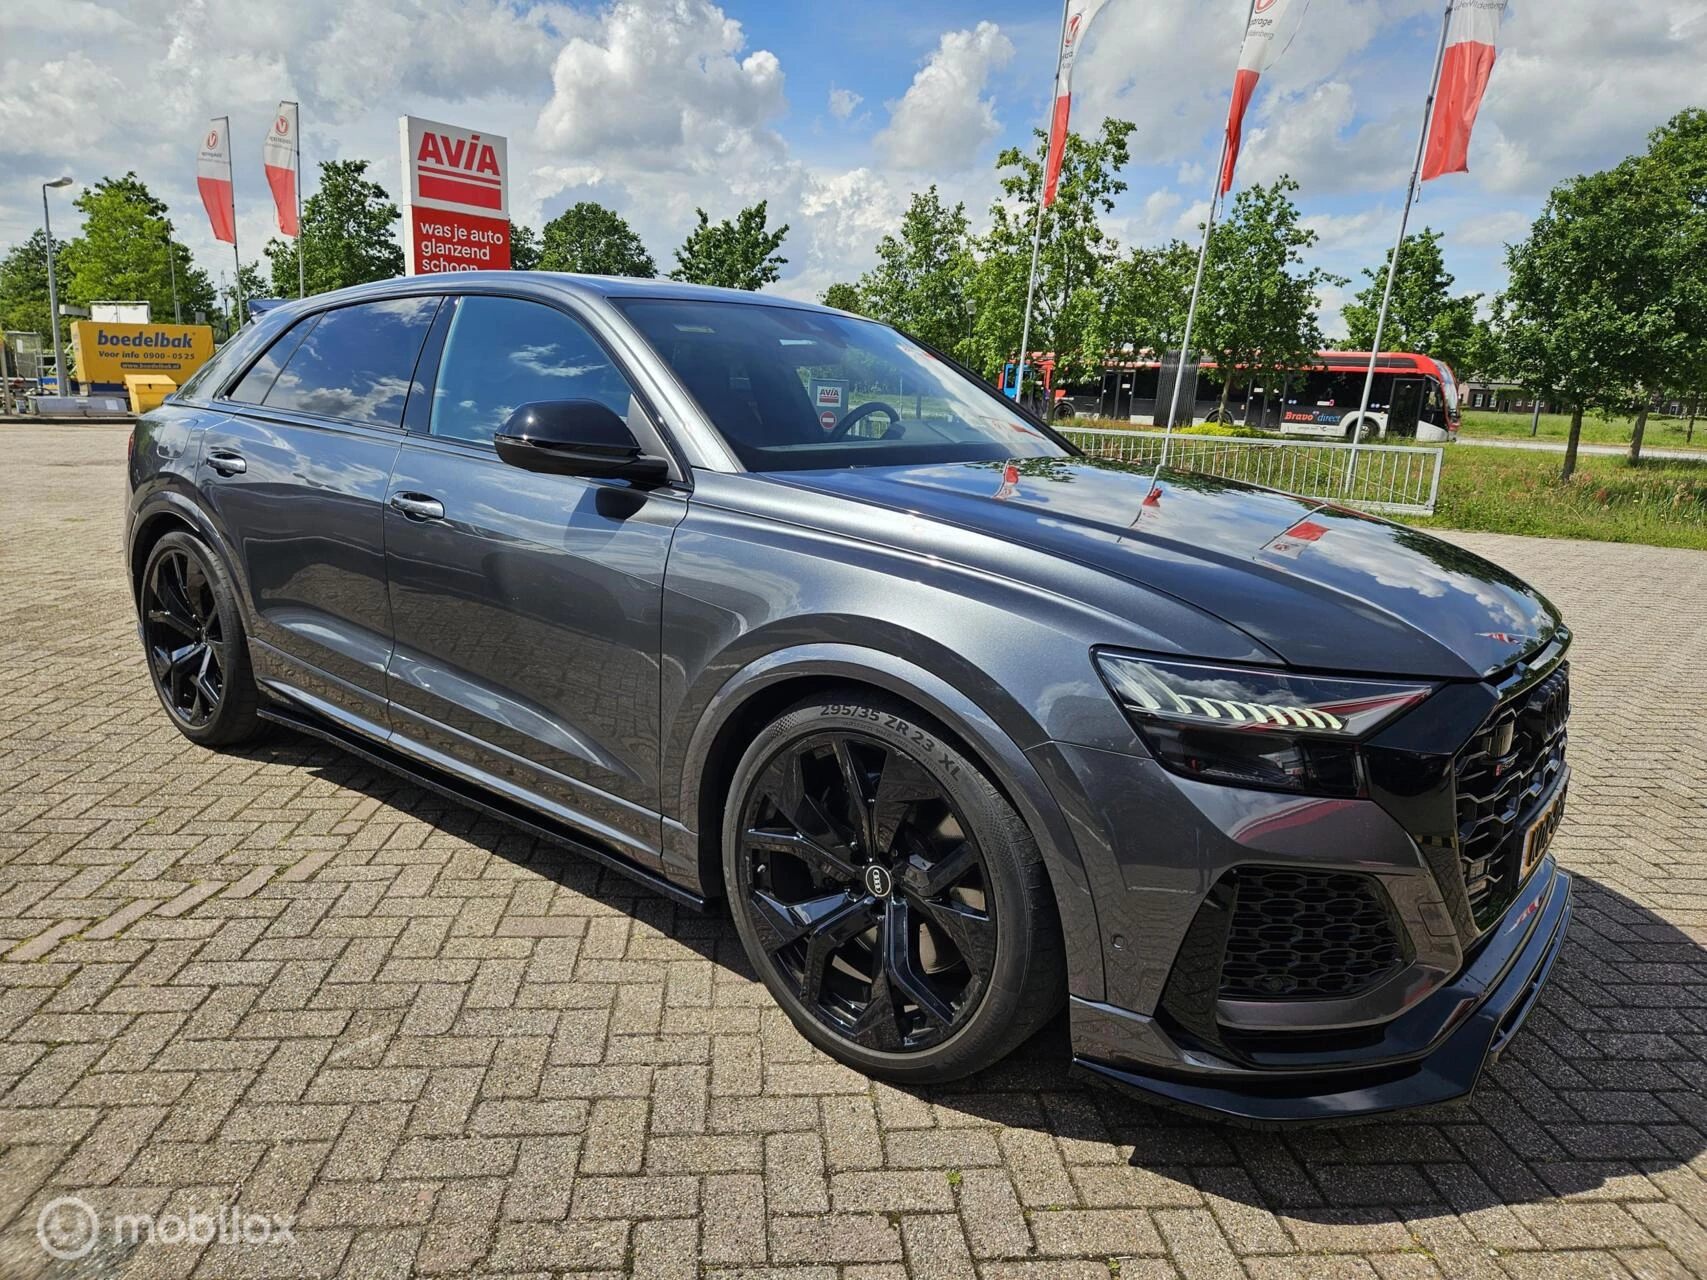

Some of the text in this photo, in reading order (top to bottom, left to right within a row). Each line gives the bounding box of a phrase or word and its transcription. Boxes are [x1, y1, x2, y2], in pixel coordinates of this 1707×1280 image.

[420, 222, 503, 245] was je auto
[421, 239, 490, 261] glanzend
[97, 330, 193, 348] boedelbak
[98, 350, 120, 359] Voor
[122, 350, 140, 359] info
[143, 352, 165, 360] 0900
[172, 352, 195, 360] 0525
[1284, 411, 1341, 422] Bravo direct
[820, 704, 965, 782] 295/35 ZR 23 XL
